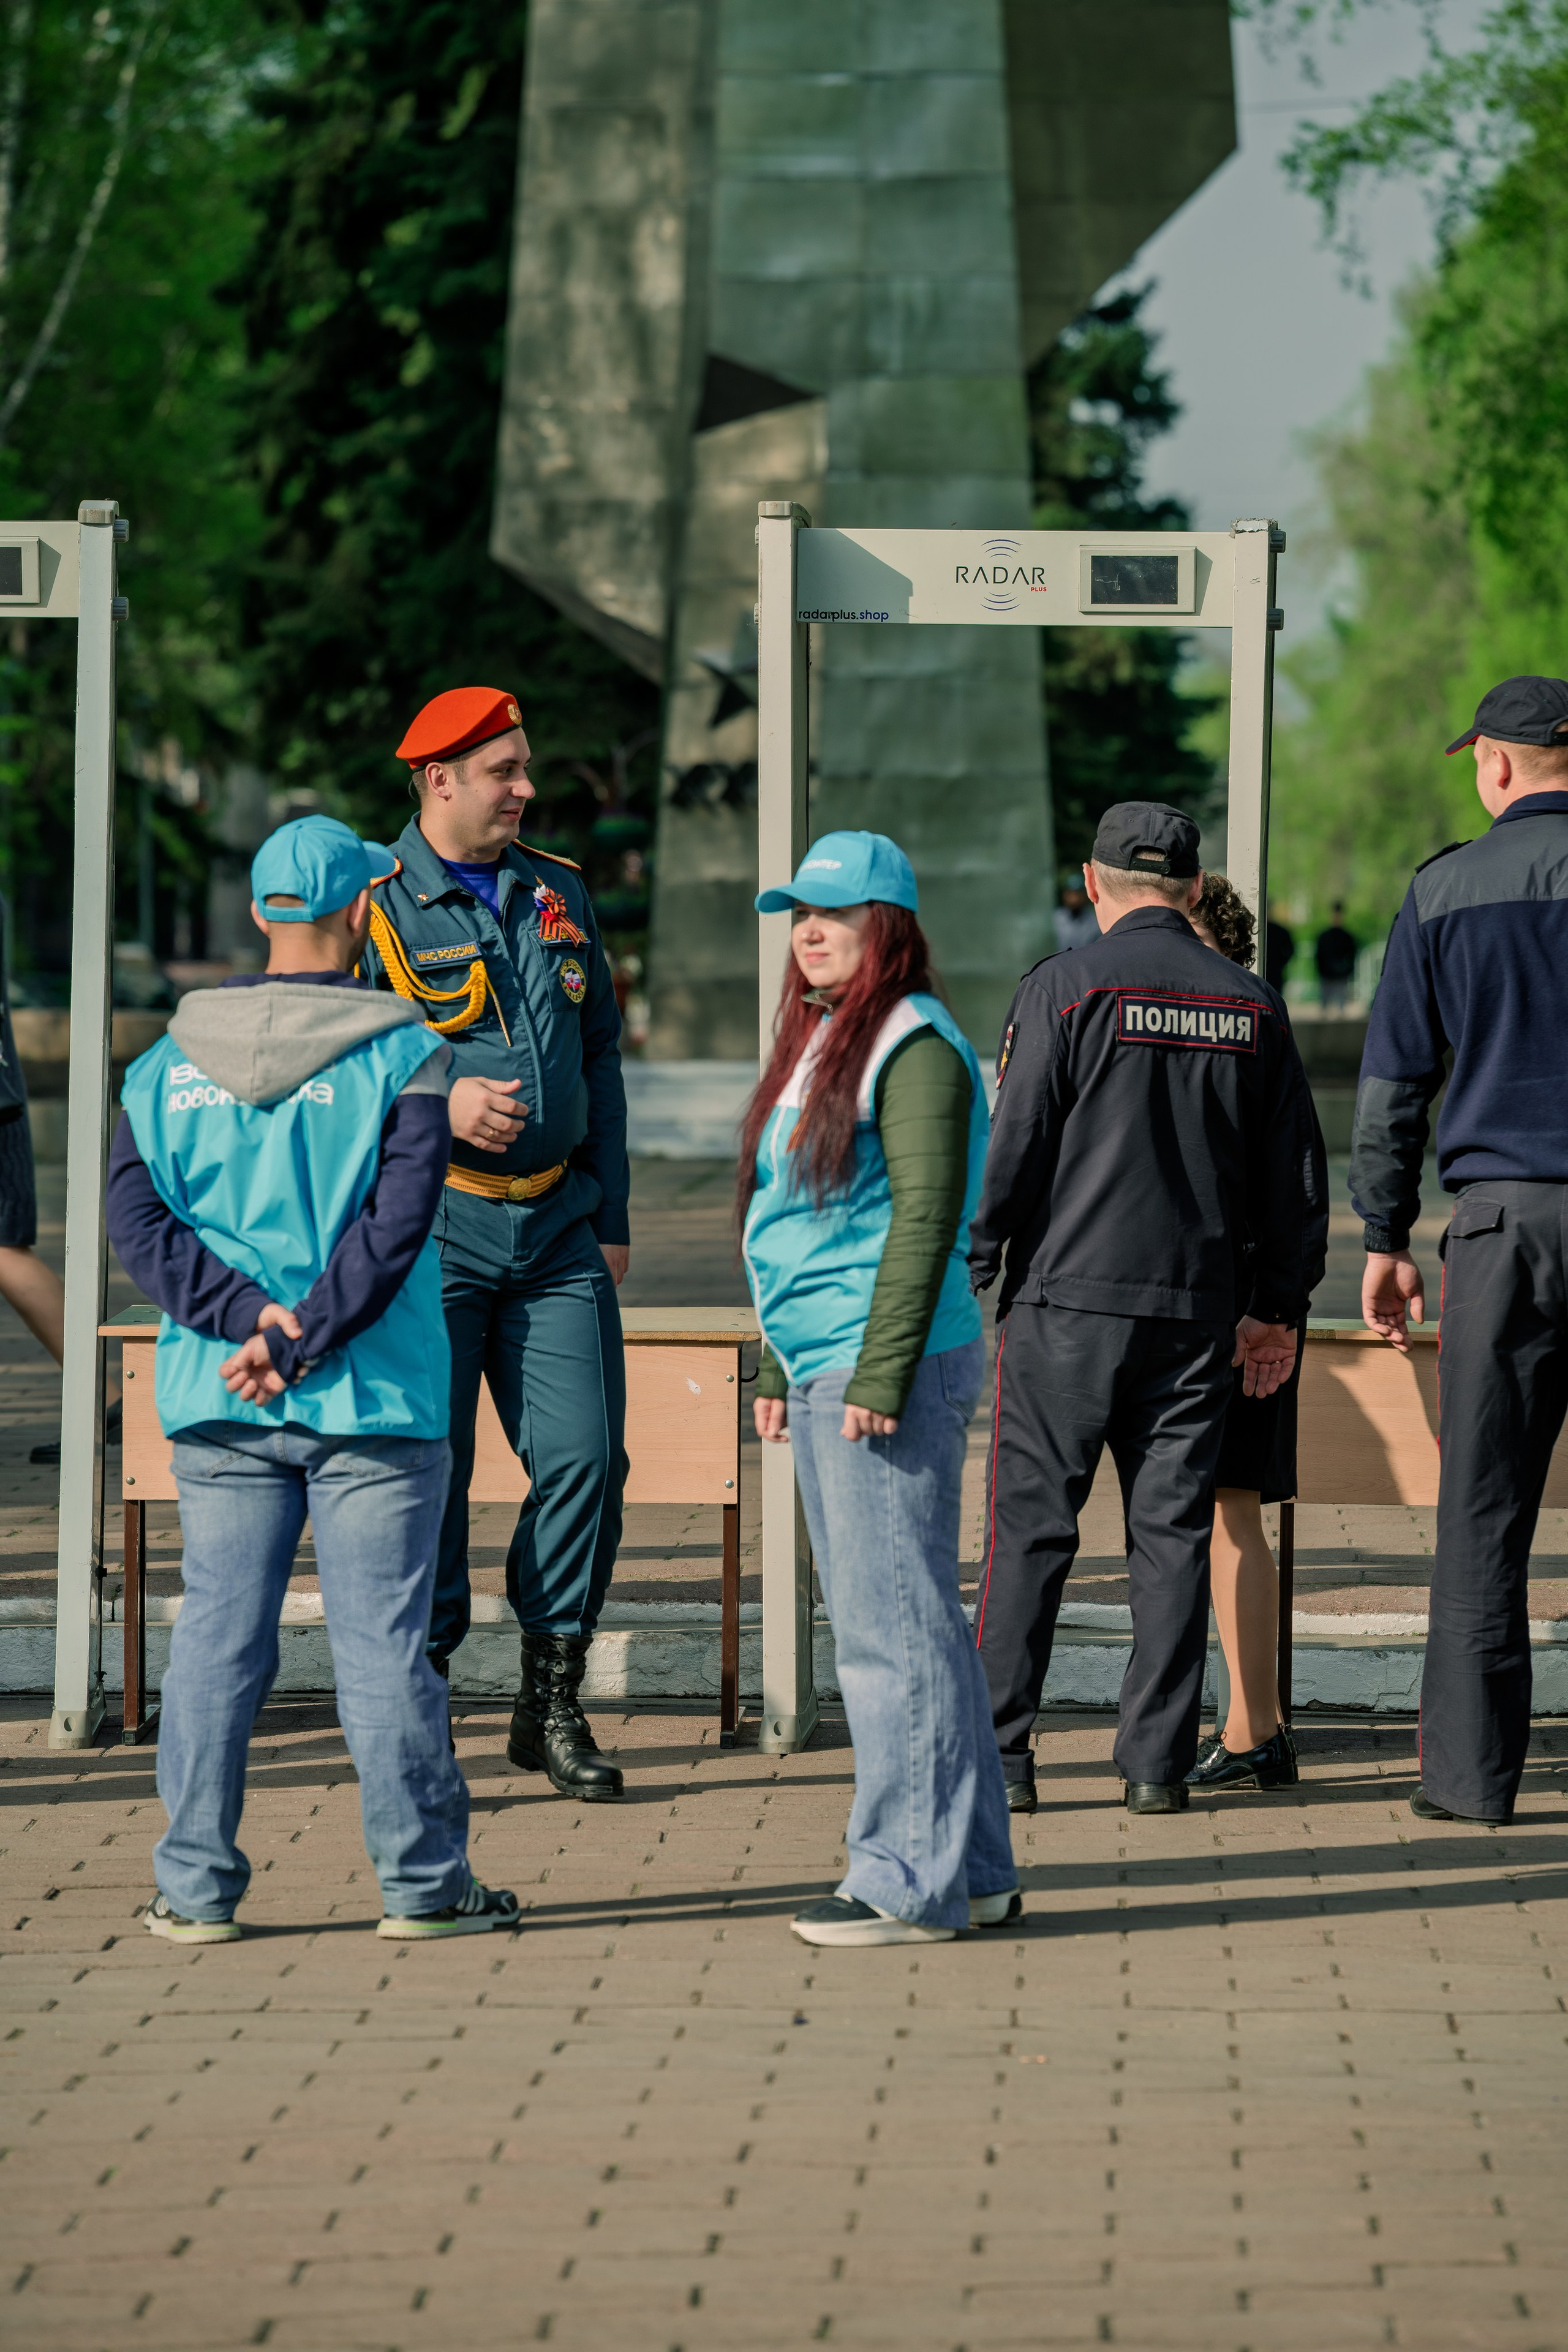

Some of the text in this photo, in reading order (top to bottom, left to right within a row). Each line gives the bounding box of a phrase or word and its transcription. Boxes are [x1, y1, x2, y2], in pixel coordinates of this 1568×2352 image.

[956, 565, 1046, 586] RADAR
[416, 944, 477, 962] МЧС РОССИИ
[1125, 1005, 1251, 1042] ПОЛИЦИЯ
